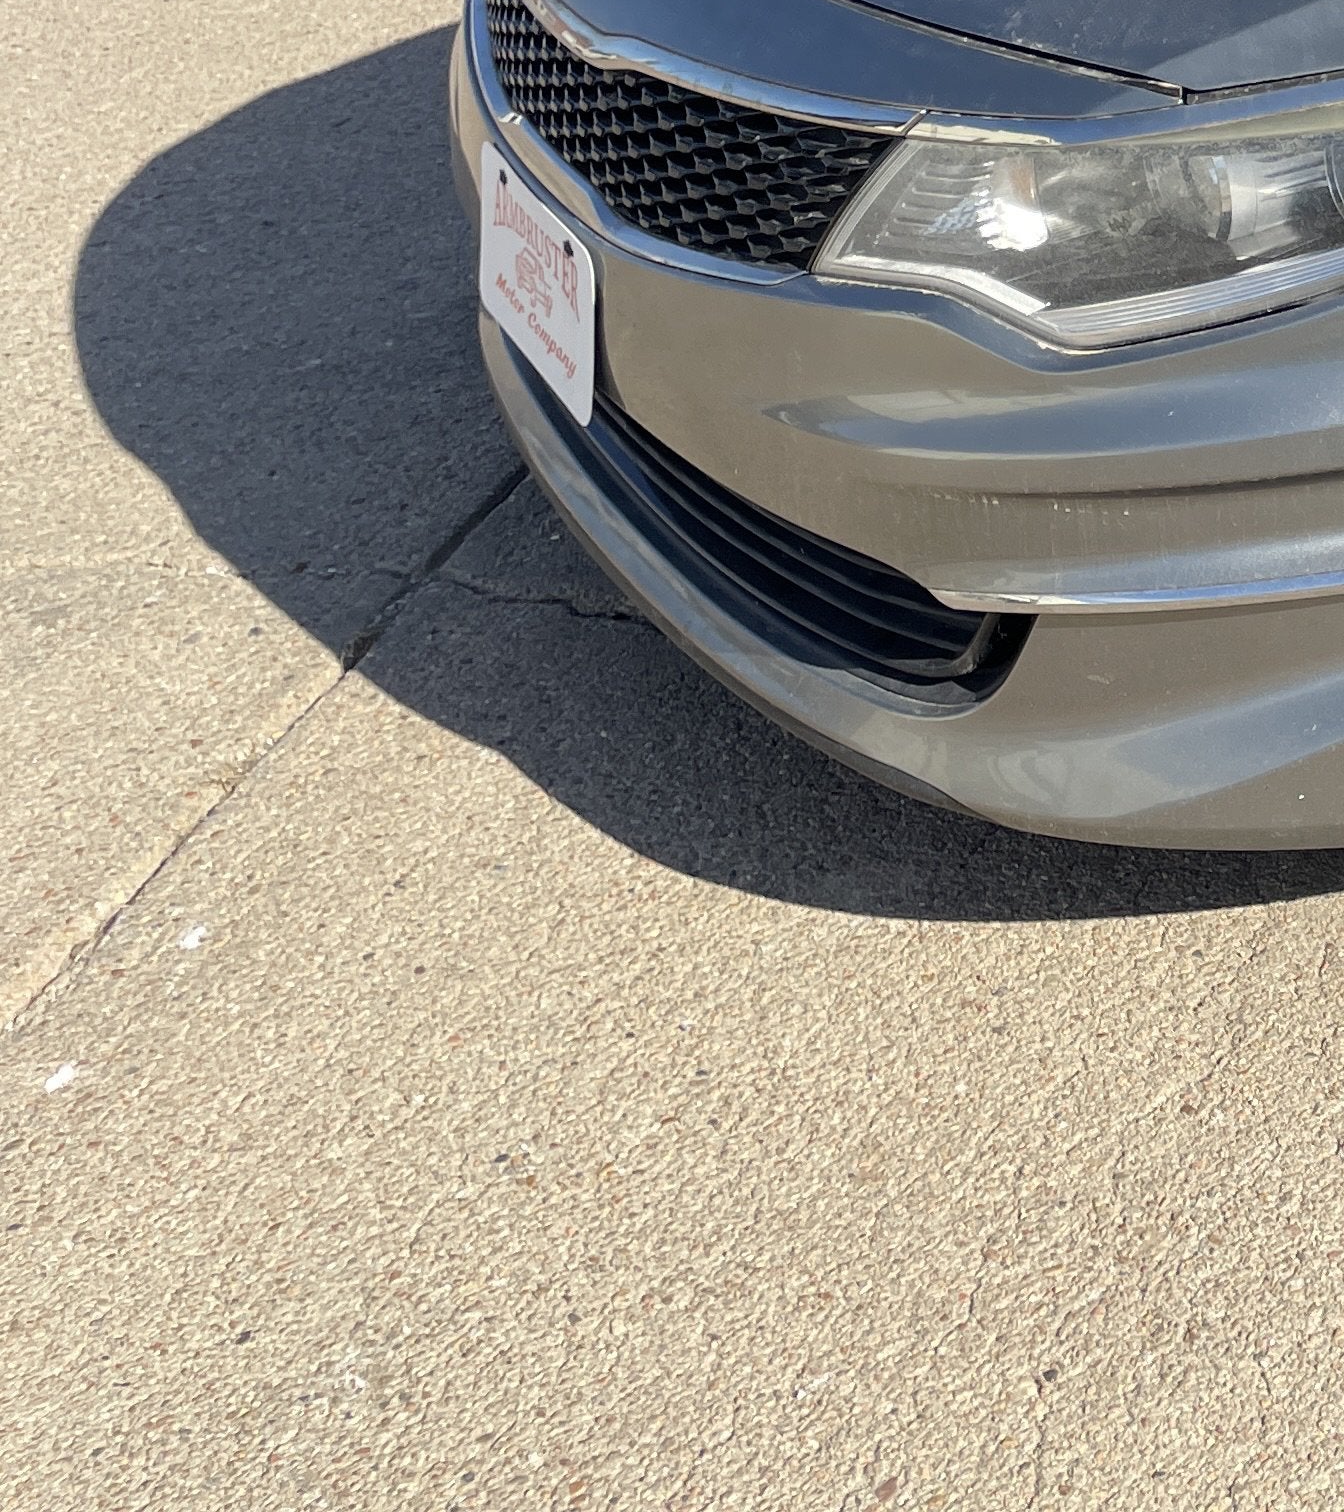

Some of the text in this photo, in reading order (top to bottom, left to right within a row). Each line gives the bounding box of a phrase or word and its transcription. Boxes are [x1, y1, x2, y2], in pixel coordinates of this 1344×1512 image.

[493, 179, 580, 322] ARMBRUSTER
[496, 272, 577, 380] Motor Company
